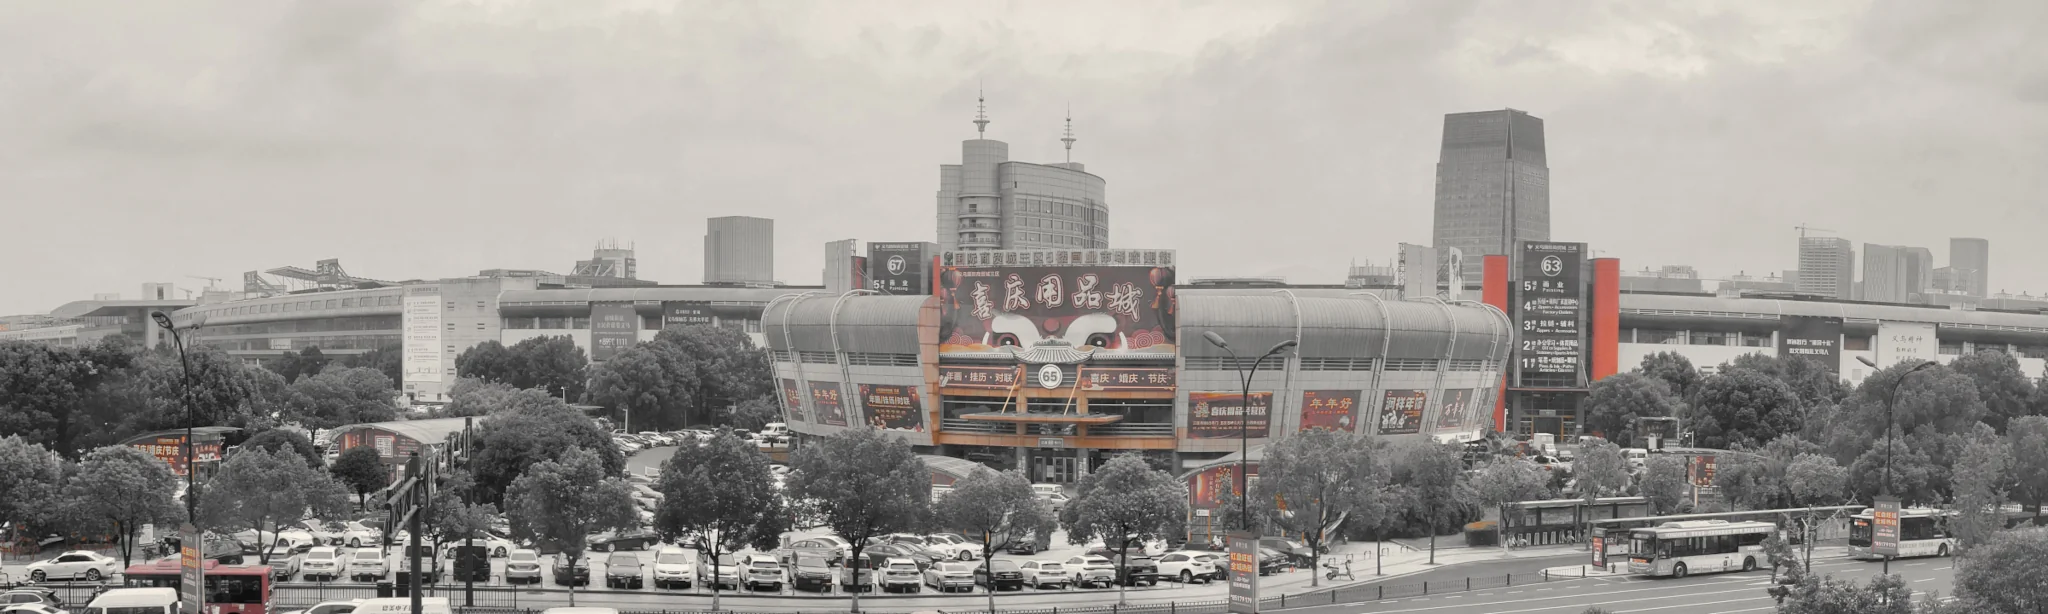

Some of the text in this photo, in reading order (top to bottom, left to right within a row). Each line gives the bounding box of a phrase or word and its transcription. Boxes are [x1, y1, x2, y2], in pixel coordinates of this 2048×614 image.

[890, 260, 902, 270] 67
[1543, 260, 1561, 271] 63
[874, 280, 880, 289] 5
[1524, 281, 1531, 291] 5
[971, 274, 1142, 321] 喜庆用品城
[1524, 301, 1531, 311] 4
[1524, 320, 1531, 330] 3
[1523, 341, 1531, 350] 2
[1522, 358, 1528, 368] 1
[946, 371, 1013, 383] 年画·挂历·对联
[1043, 371, 1058, 381] 65
[1090, 373, 1167, 384] 喜庆·婚庆·节庆
[1309, 397, 1352, 410] 年年好
